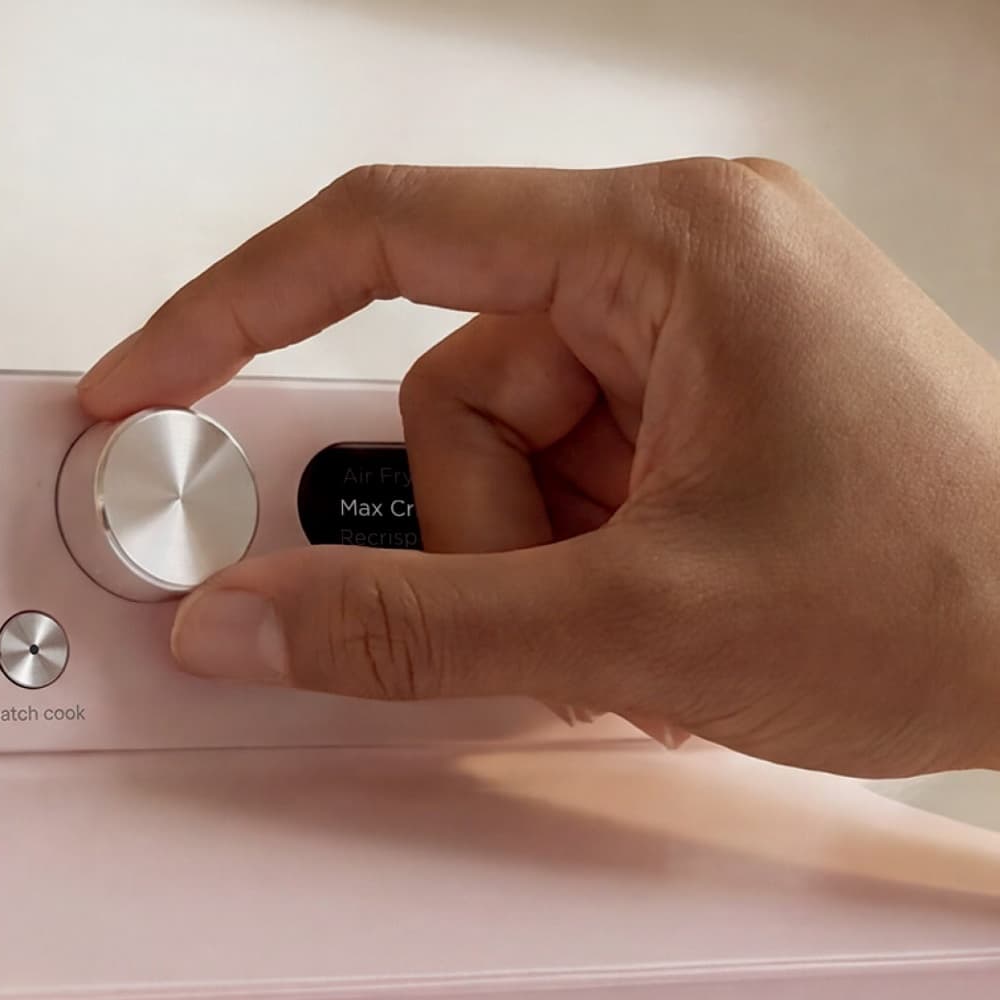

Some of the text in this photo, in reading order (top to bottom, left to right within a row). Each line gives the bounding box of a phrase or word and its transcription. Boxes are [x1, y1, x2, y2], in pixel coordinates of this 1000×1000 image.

[343, 467, 373, 485] Air
[340, 498, 383, 517] Max
[340, 528, 418, 548] Recrisp
[43, 704, 86, 721] cook
